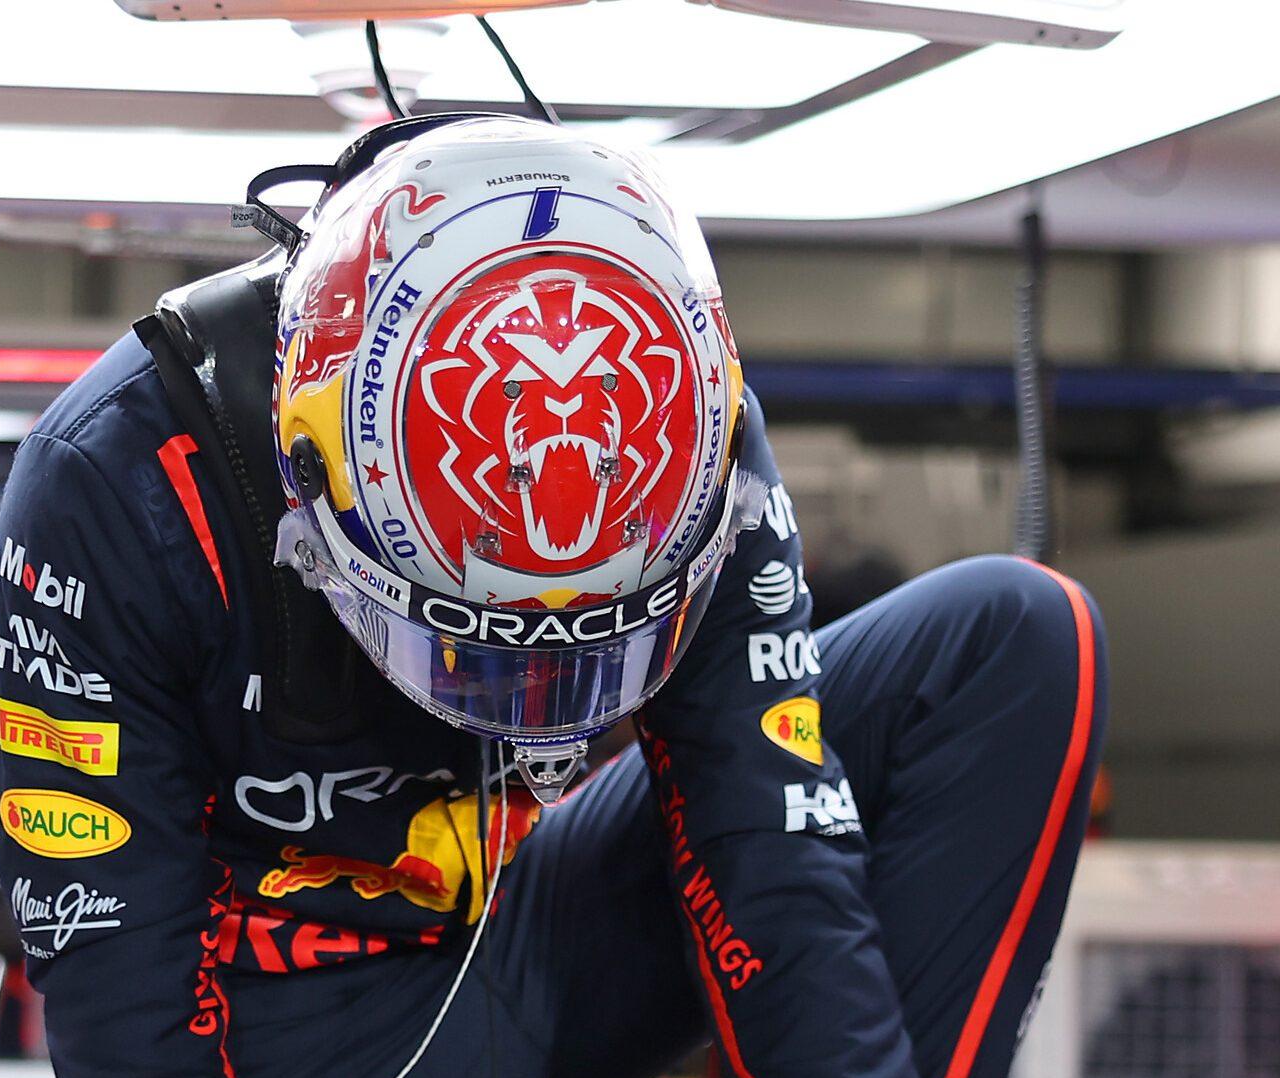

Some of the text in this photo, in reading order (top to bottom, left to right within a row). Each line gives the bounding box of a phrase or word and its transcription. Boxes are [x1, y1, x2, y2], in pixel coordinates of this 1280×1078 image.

[486, 173, 571, 188] SCHUBERTH
[522, 186, 563, 241] 1
[360, 279, 422, 448] Heineken
[664, 408, 721, 565] Heineken
[0, 537, 85, 620] Mobil
[348, 557, 385, 594] Mobil
[421, 576, 679, 645] ORACLE
[0, 709, 104, 765] PIRELLI
[20, 806, 110, 841] RAUCH
[11, 877, 127, 951] Maui Jim
